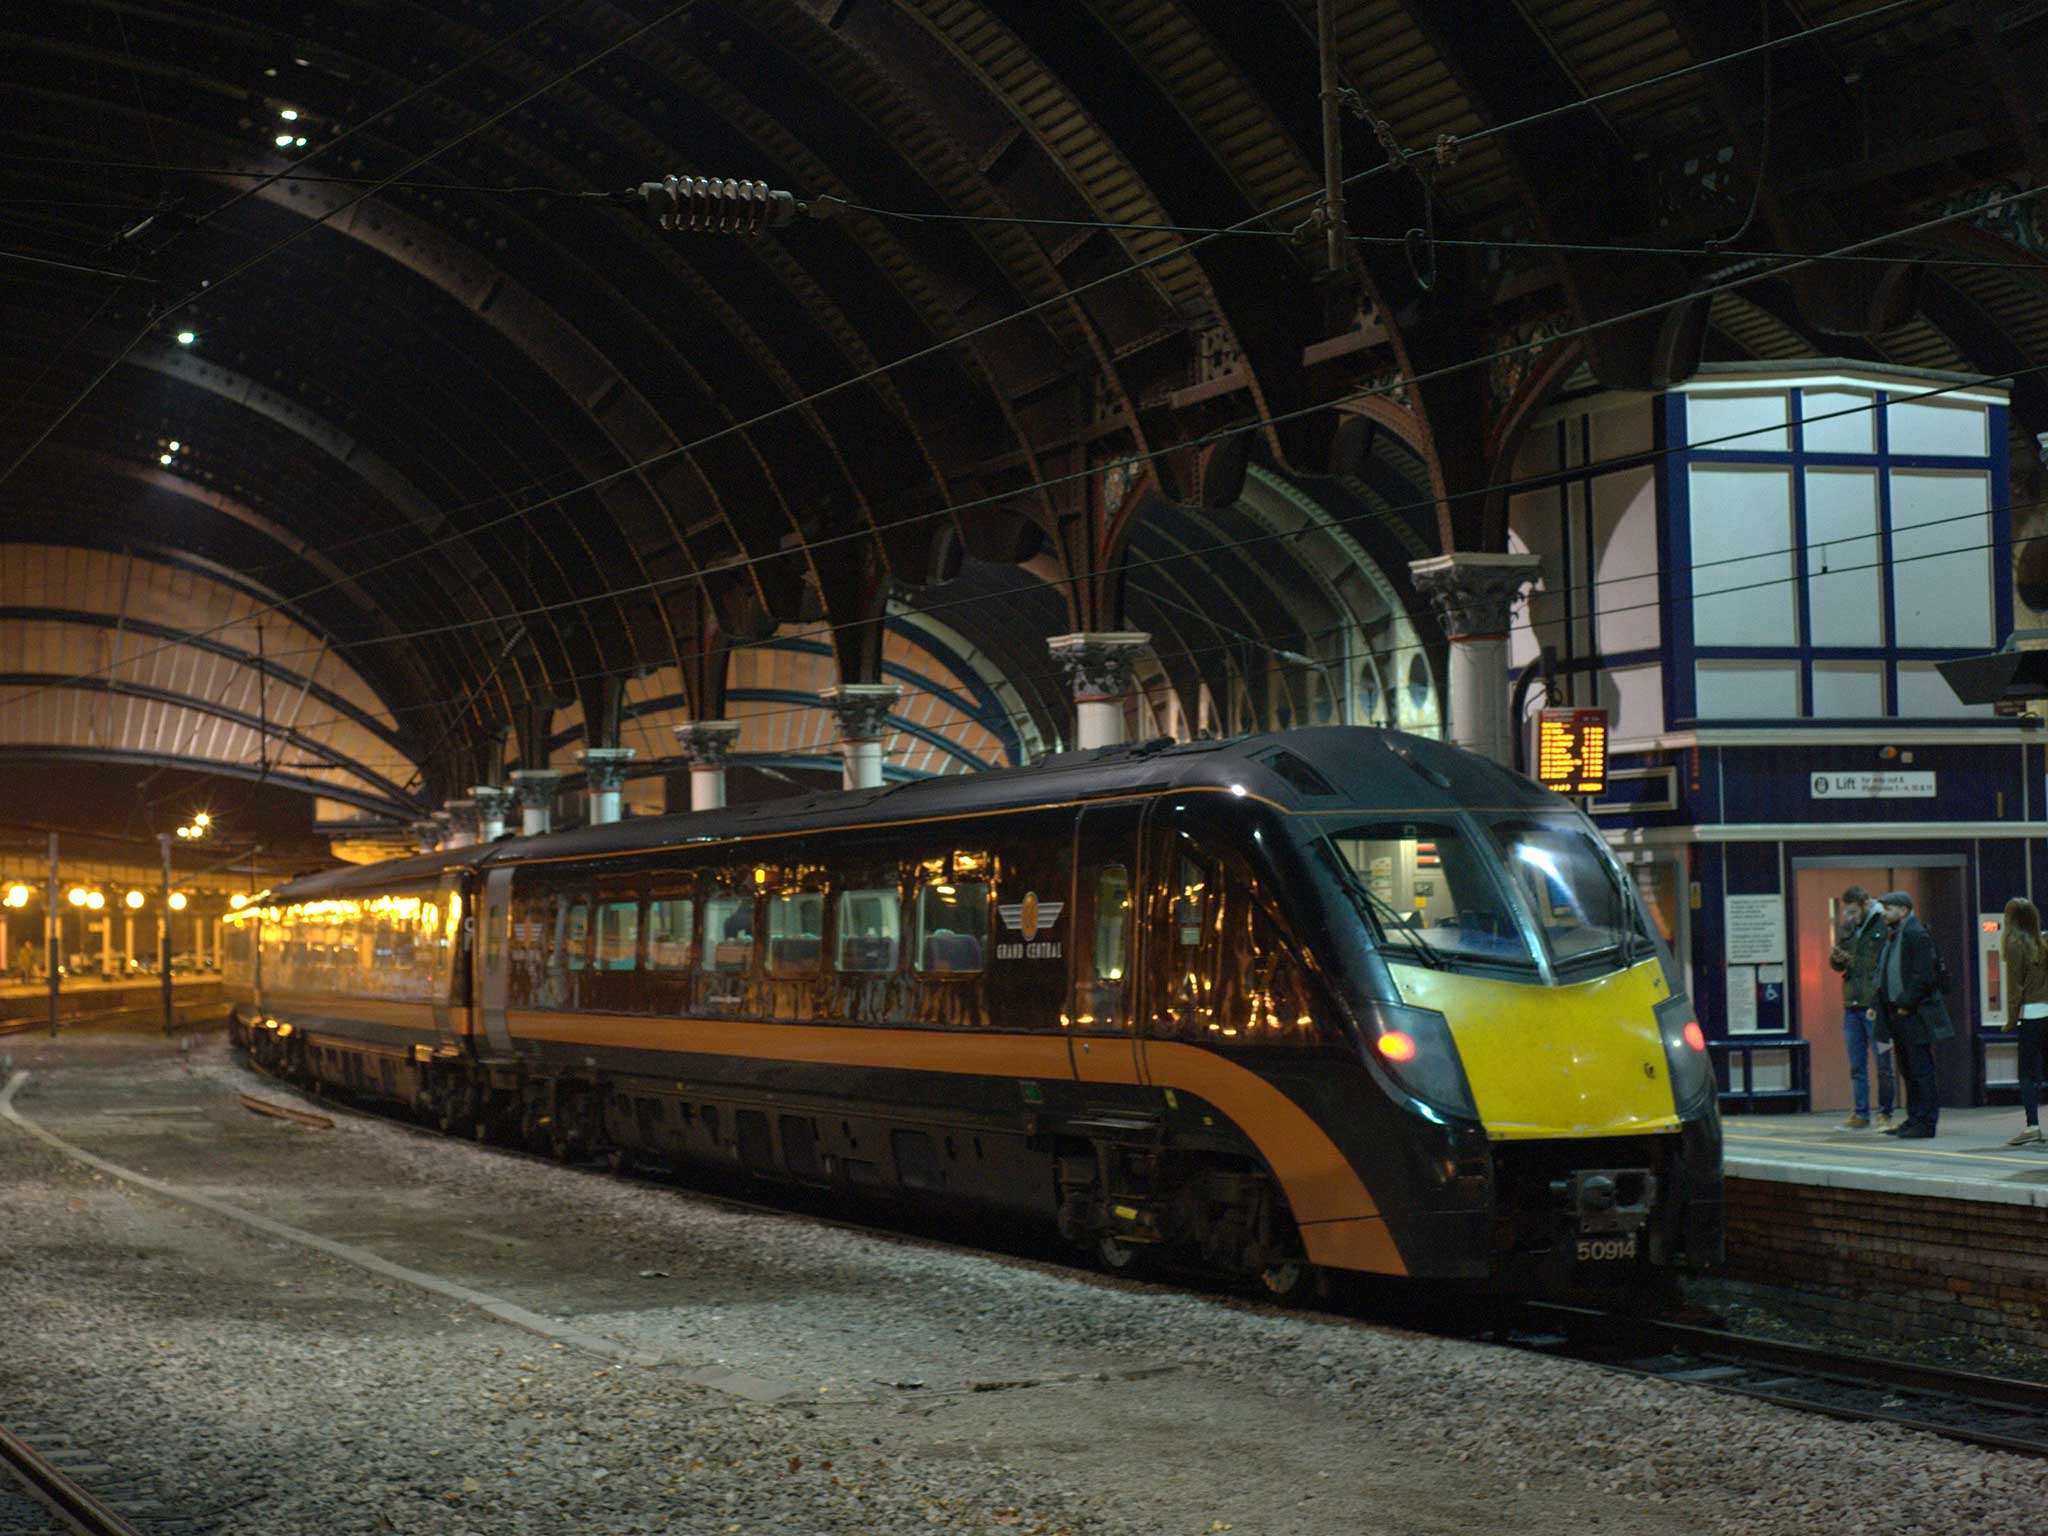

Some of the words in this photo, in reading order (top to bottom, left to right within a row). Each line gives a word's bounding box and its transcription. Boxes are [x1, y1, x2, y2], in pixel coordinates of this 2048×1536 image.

[1836, 777, 1856, 790] Lift
[997, 943, 1024, 959] GRAND
[1026, 942, 1062, 958] CENTRAL
[1577, 1240, 1635, 1260] 50914
